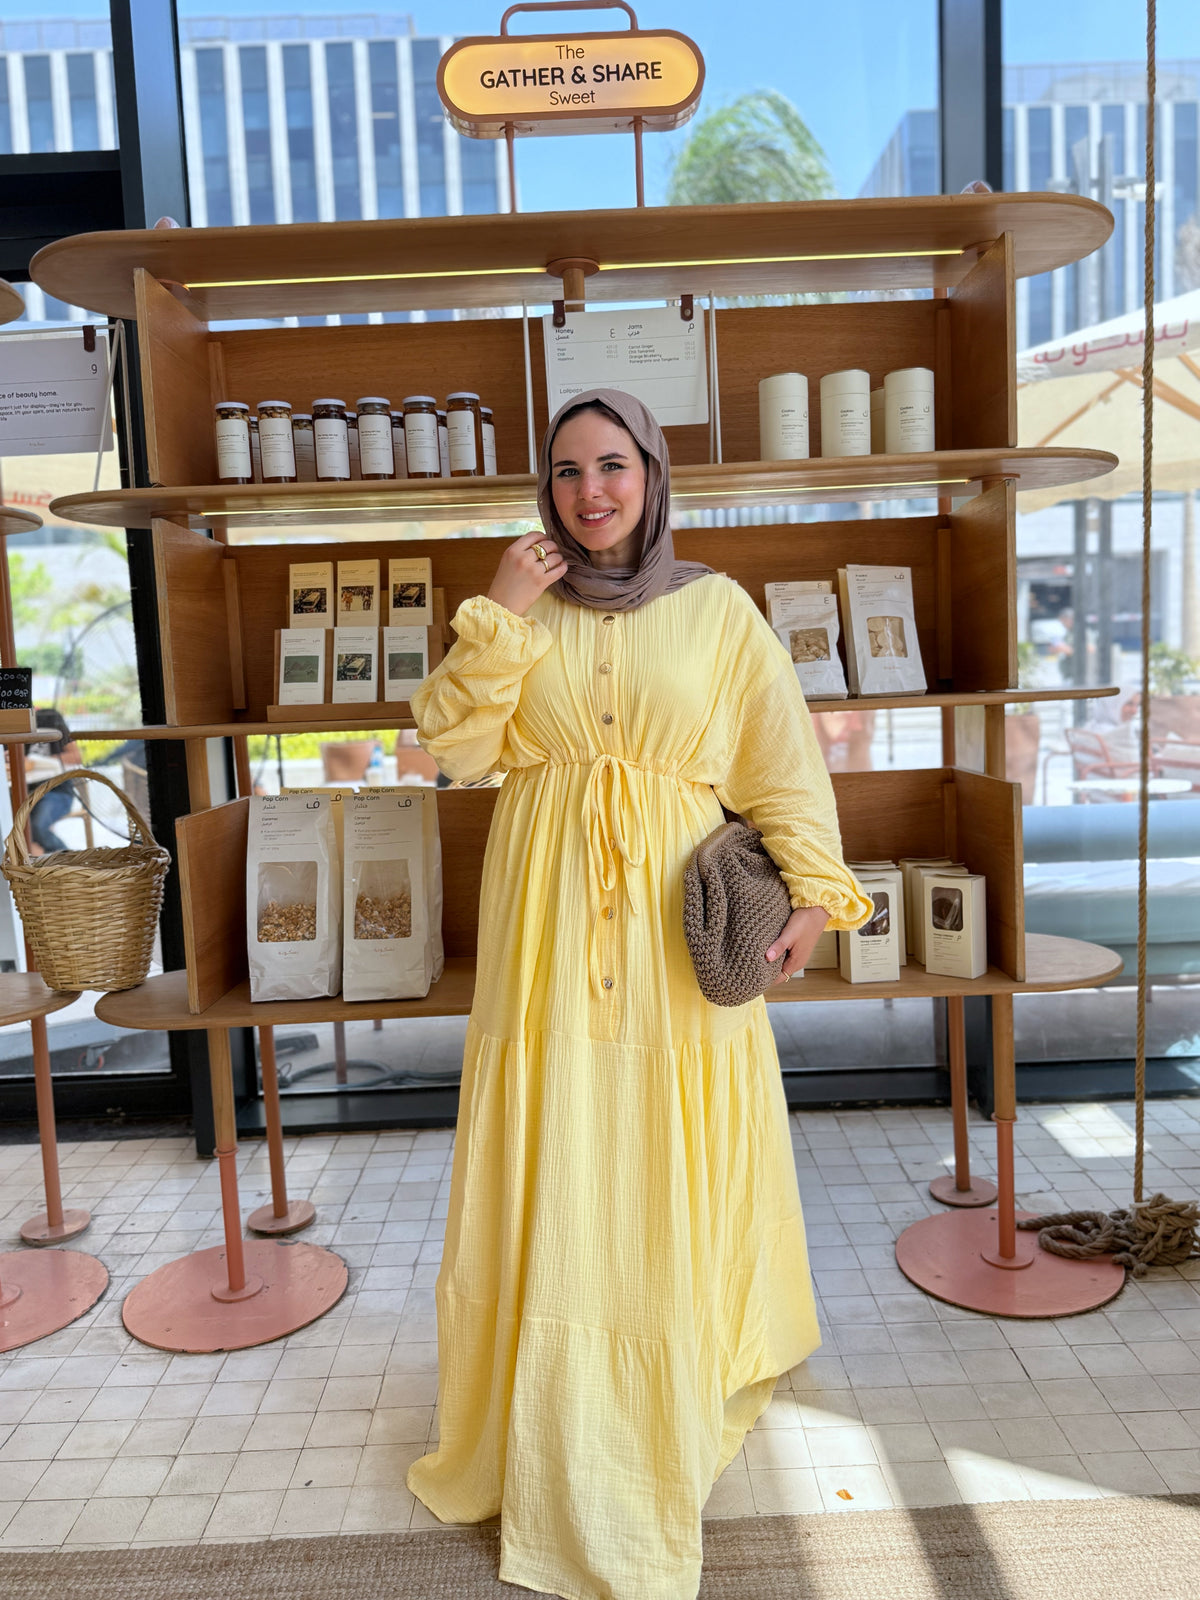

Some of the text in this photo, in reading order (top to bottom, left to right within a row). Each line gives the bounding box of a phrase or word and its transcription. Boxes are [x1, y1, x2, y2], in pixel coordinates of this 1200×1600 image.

[555, 45, 585, 60] The
[480, 62, 662, 89] GATHER & SHARE
[550, 90, 595, 105] Sweet
